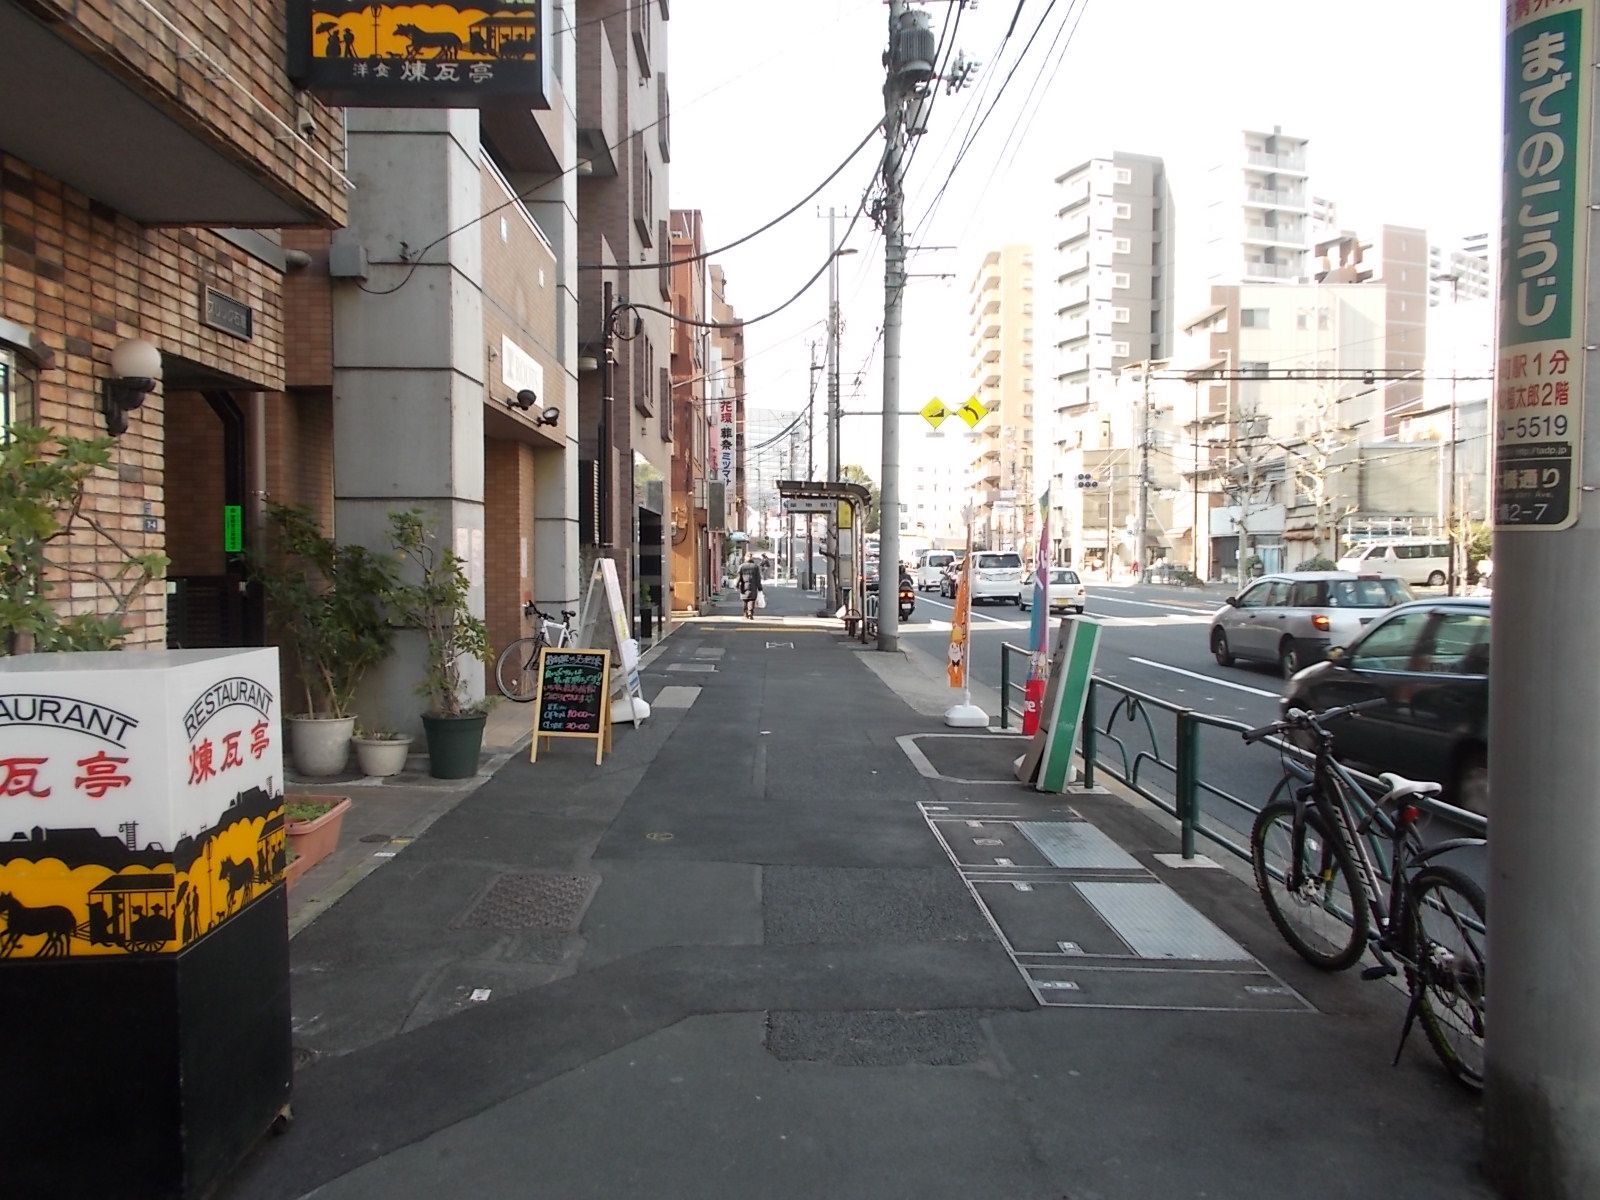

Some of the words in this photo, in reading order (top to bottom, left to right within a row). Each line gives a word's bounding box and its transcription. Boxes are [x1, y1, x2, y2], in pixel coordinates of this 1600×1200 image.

[353, 61, 391, 79] 洋食
[400, 60, 494, 84] 煉瓦亭
[1517, 31, 1572, 327] までのこうじ
[184, 680, 274, 740] RESTAURANT
[188, 720, 271, 785] 煉瓦亭
